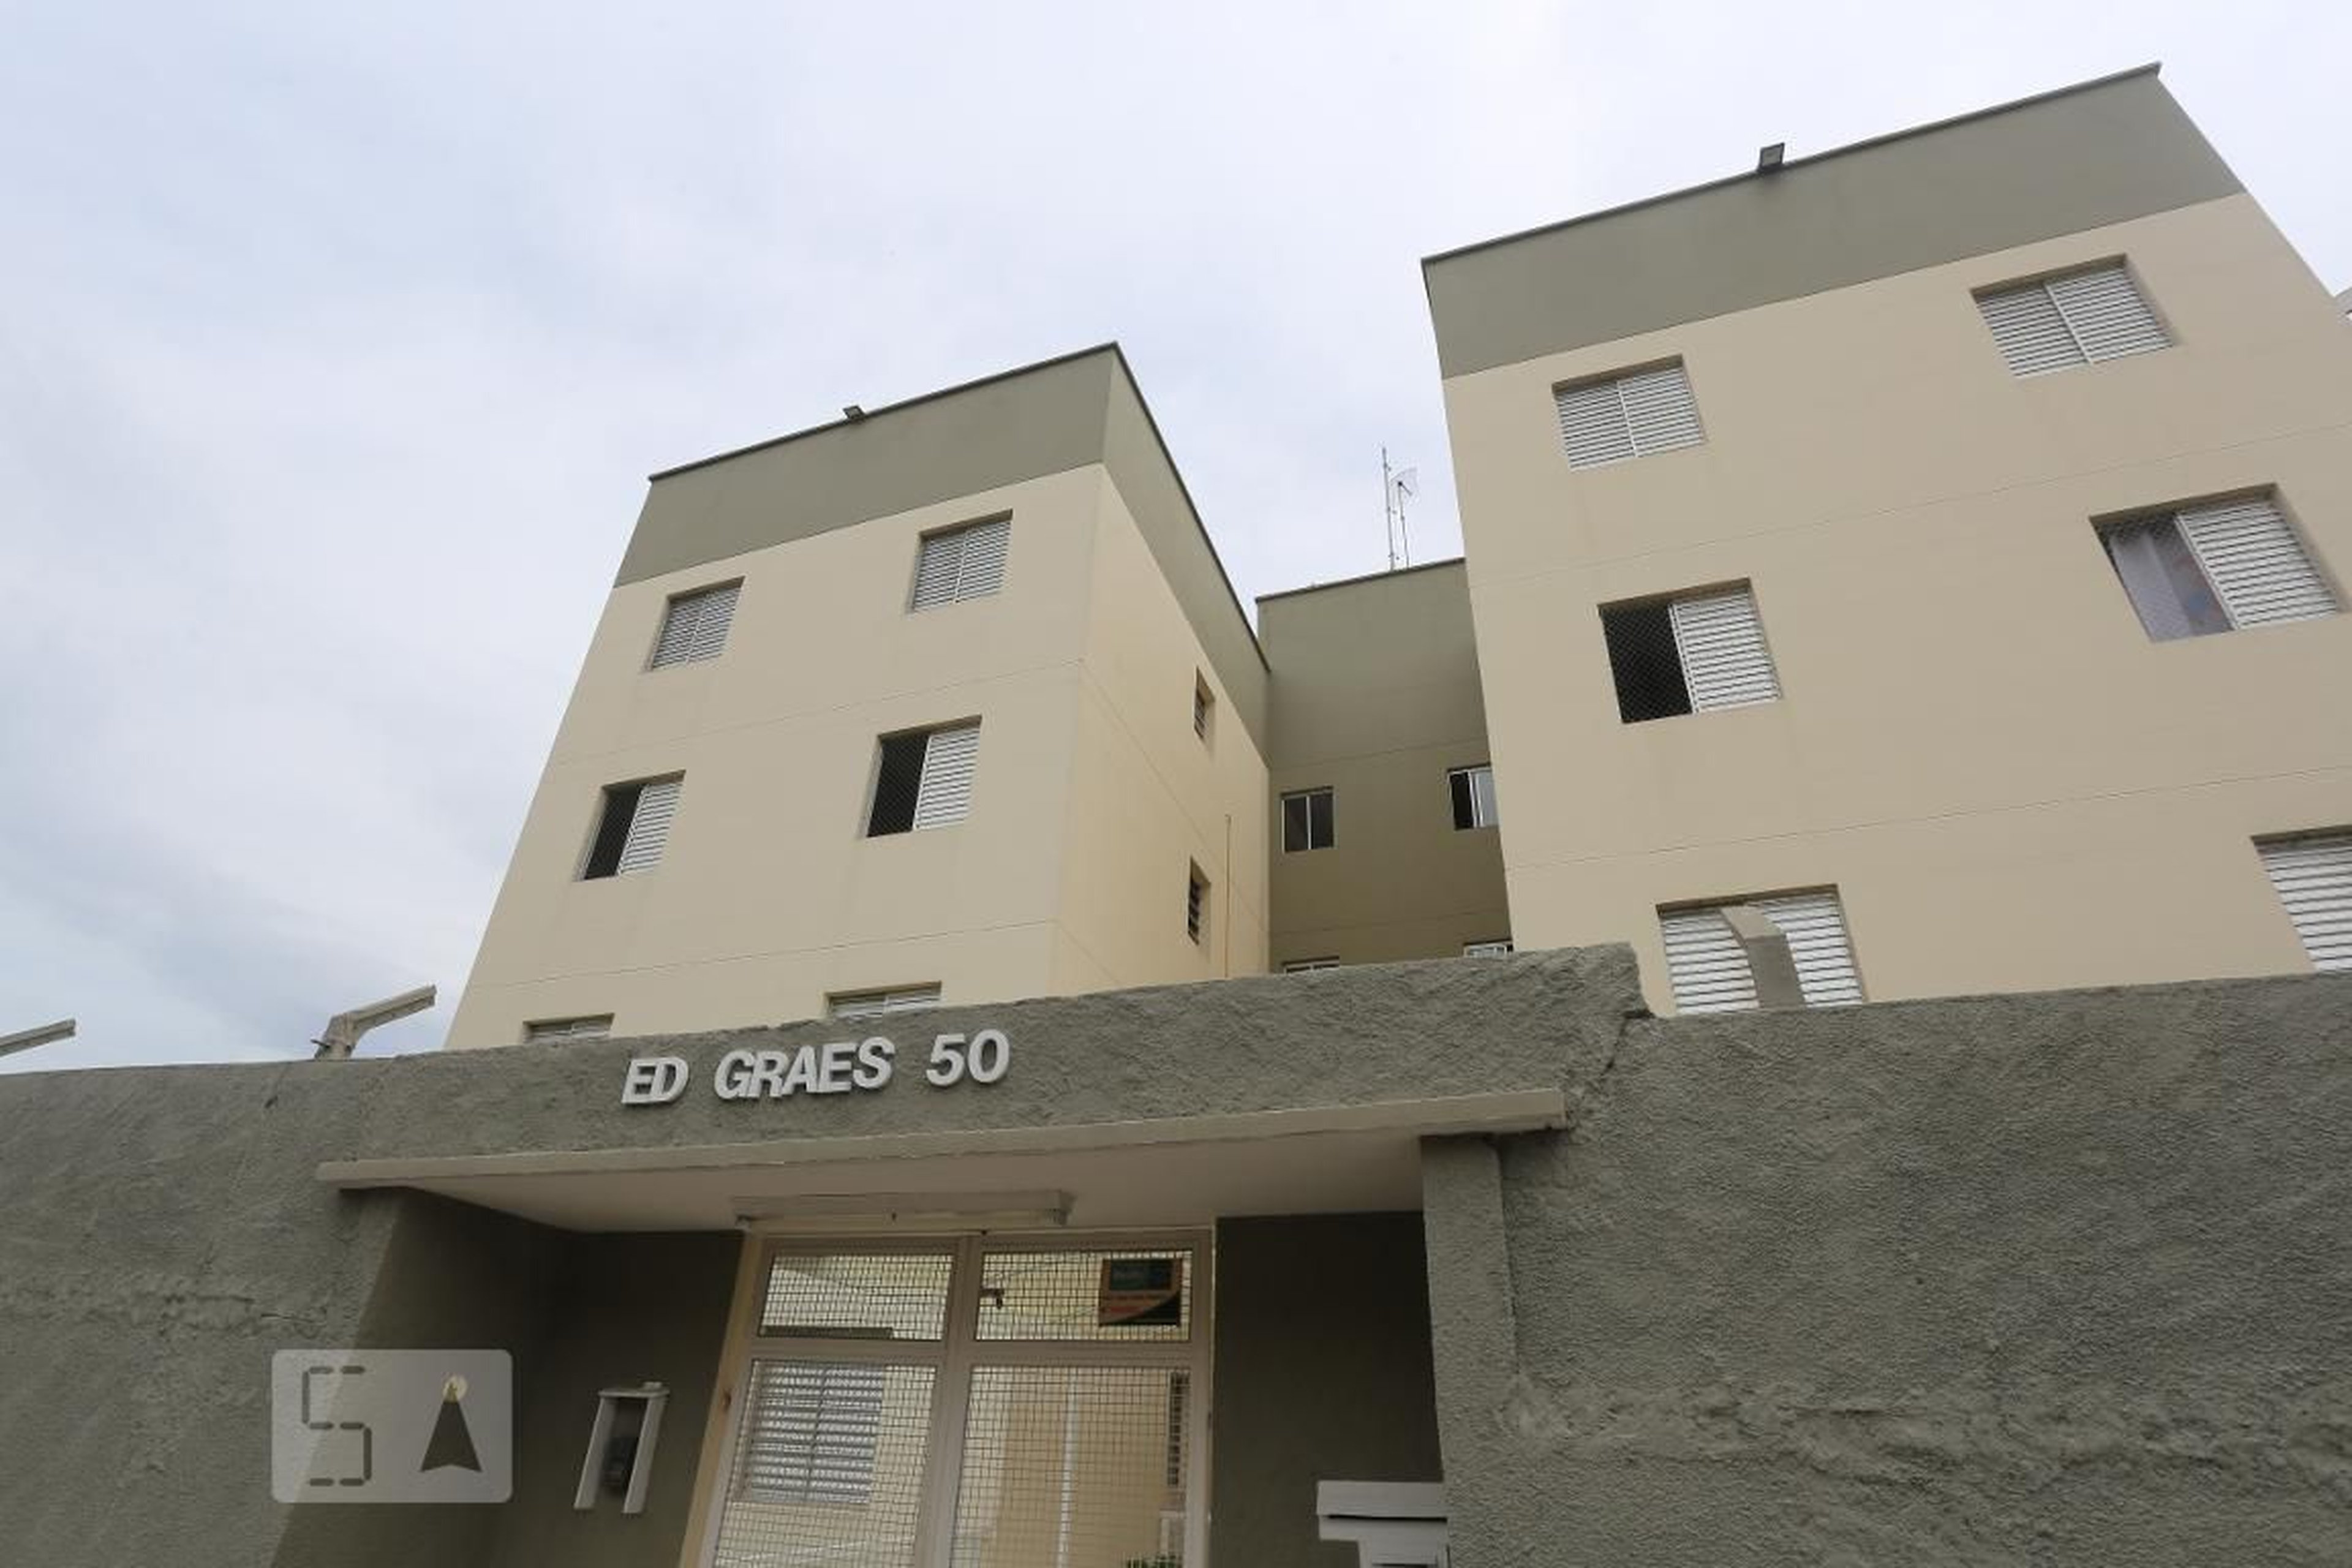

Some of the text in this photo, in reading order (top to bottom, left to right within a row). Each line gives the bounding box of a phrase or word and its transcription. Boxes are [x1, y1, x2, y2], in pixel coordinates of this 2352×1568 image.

[621, 1029, 1010, 1104] ED GRAES 50
